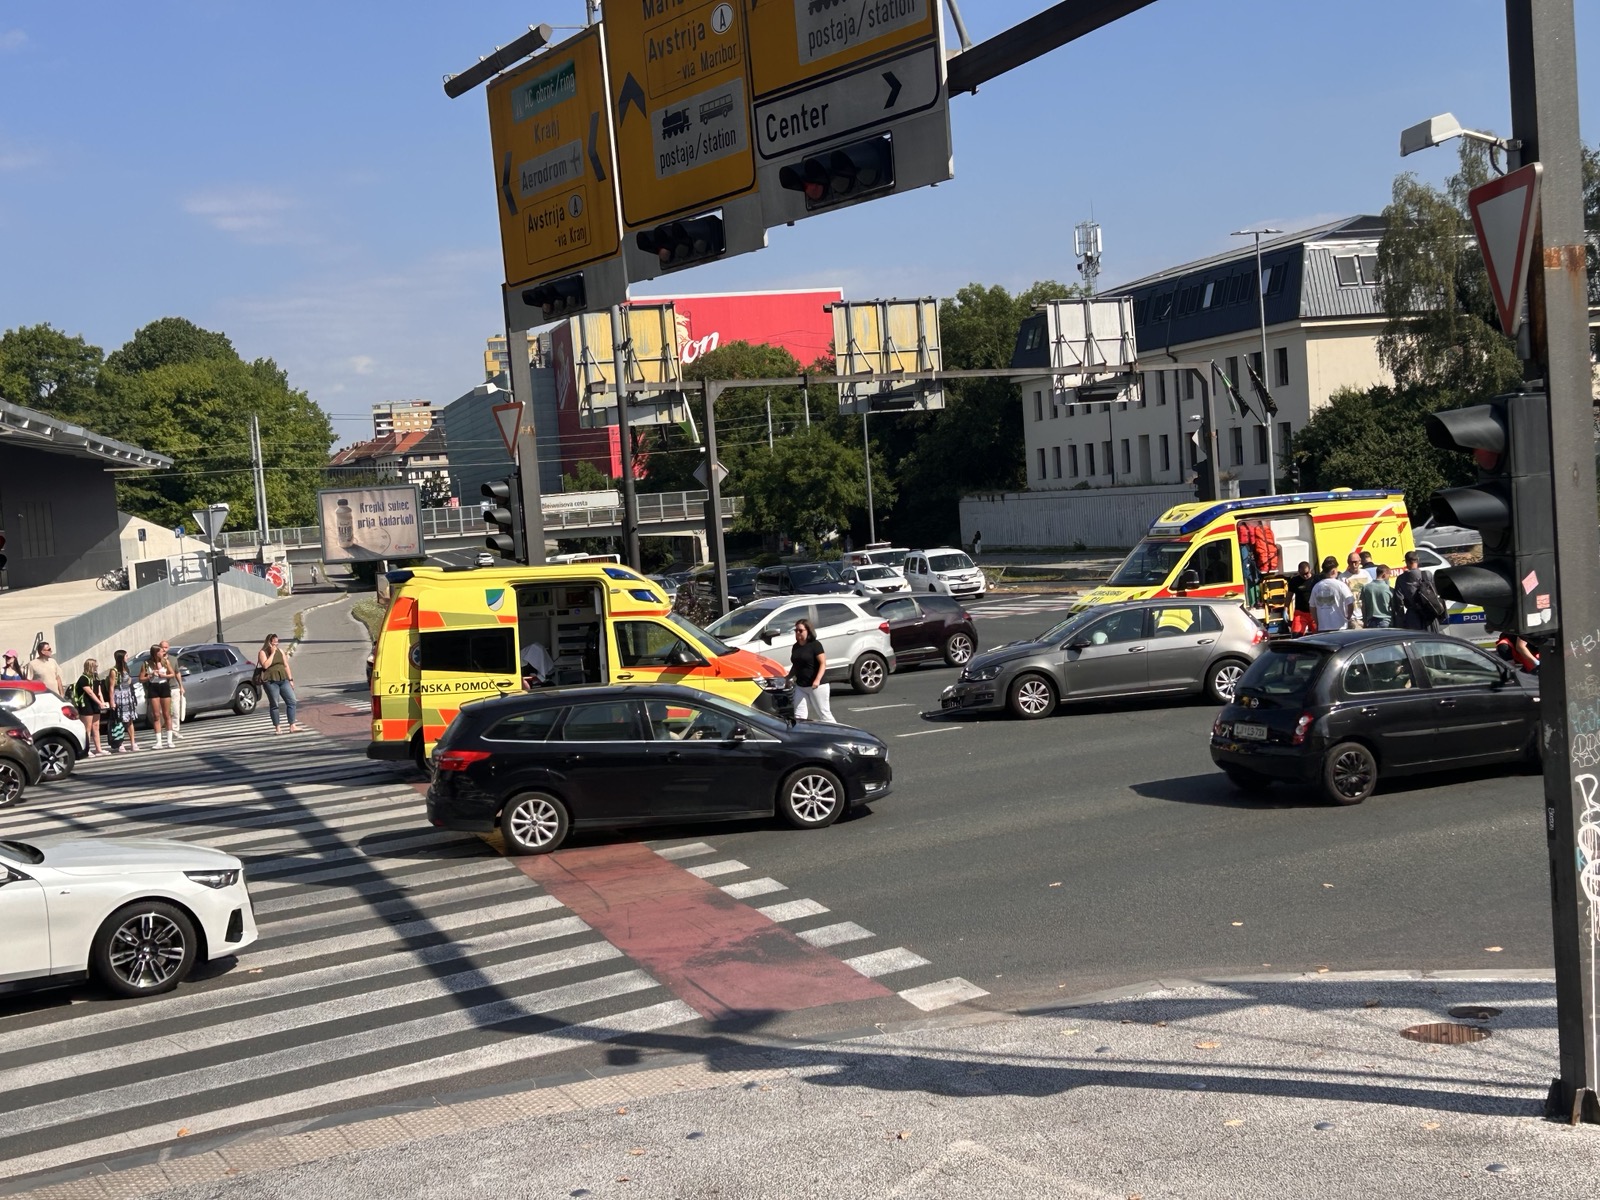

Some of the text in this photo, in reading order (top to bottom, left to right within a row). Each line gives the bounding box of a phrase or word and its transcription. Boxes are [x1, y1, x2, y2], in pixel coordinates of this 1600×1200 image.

[648, 20, 706, 63] Avstrija
[807, 0, 915, 57] postaja/station
[700, 43, 737, 72] Maribor
[533, 115, 560, 144] Kranj
[765, 102, 829, 143] Center
[659, 127, 737, 175] postaja/station
[522, 160, 568, 192] Aerodrom
[527, 204, 566, 234] Avstrija
[569, 225, 588, 244] Kranj
[679, 331, 720, 364] on
[378, 513, 415, 527] kadarkoli
[1380, 536, 1397, 548] 112
[399, 682, 421, 694] 112
[455, 680, 496, 692] POMOČ
